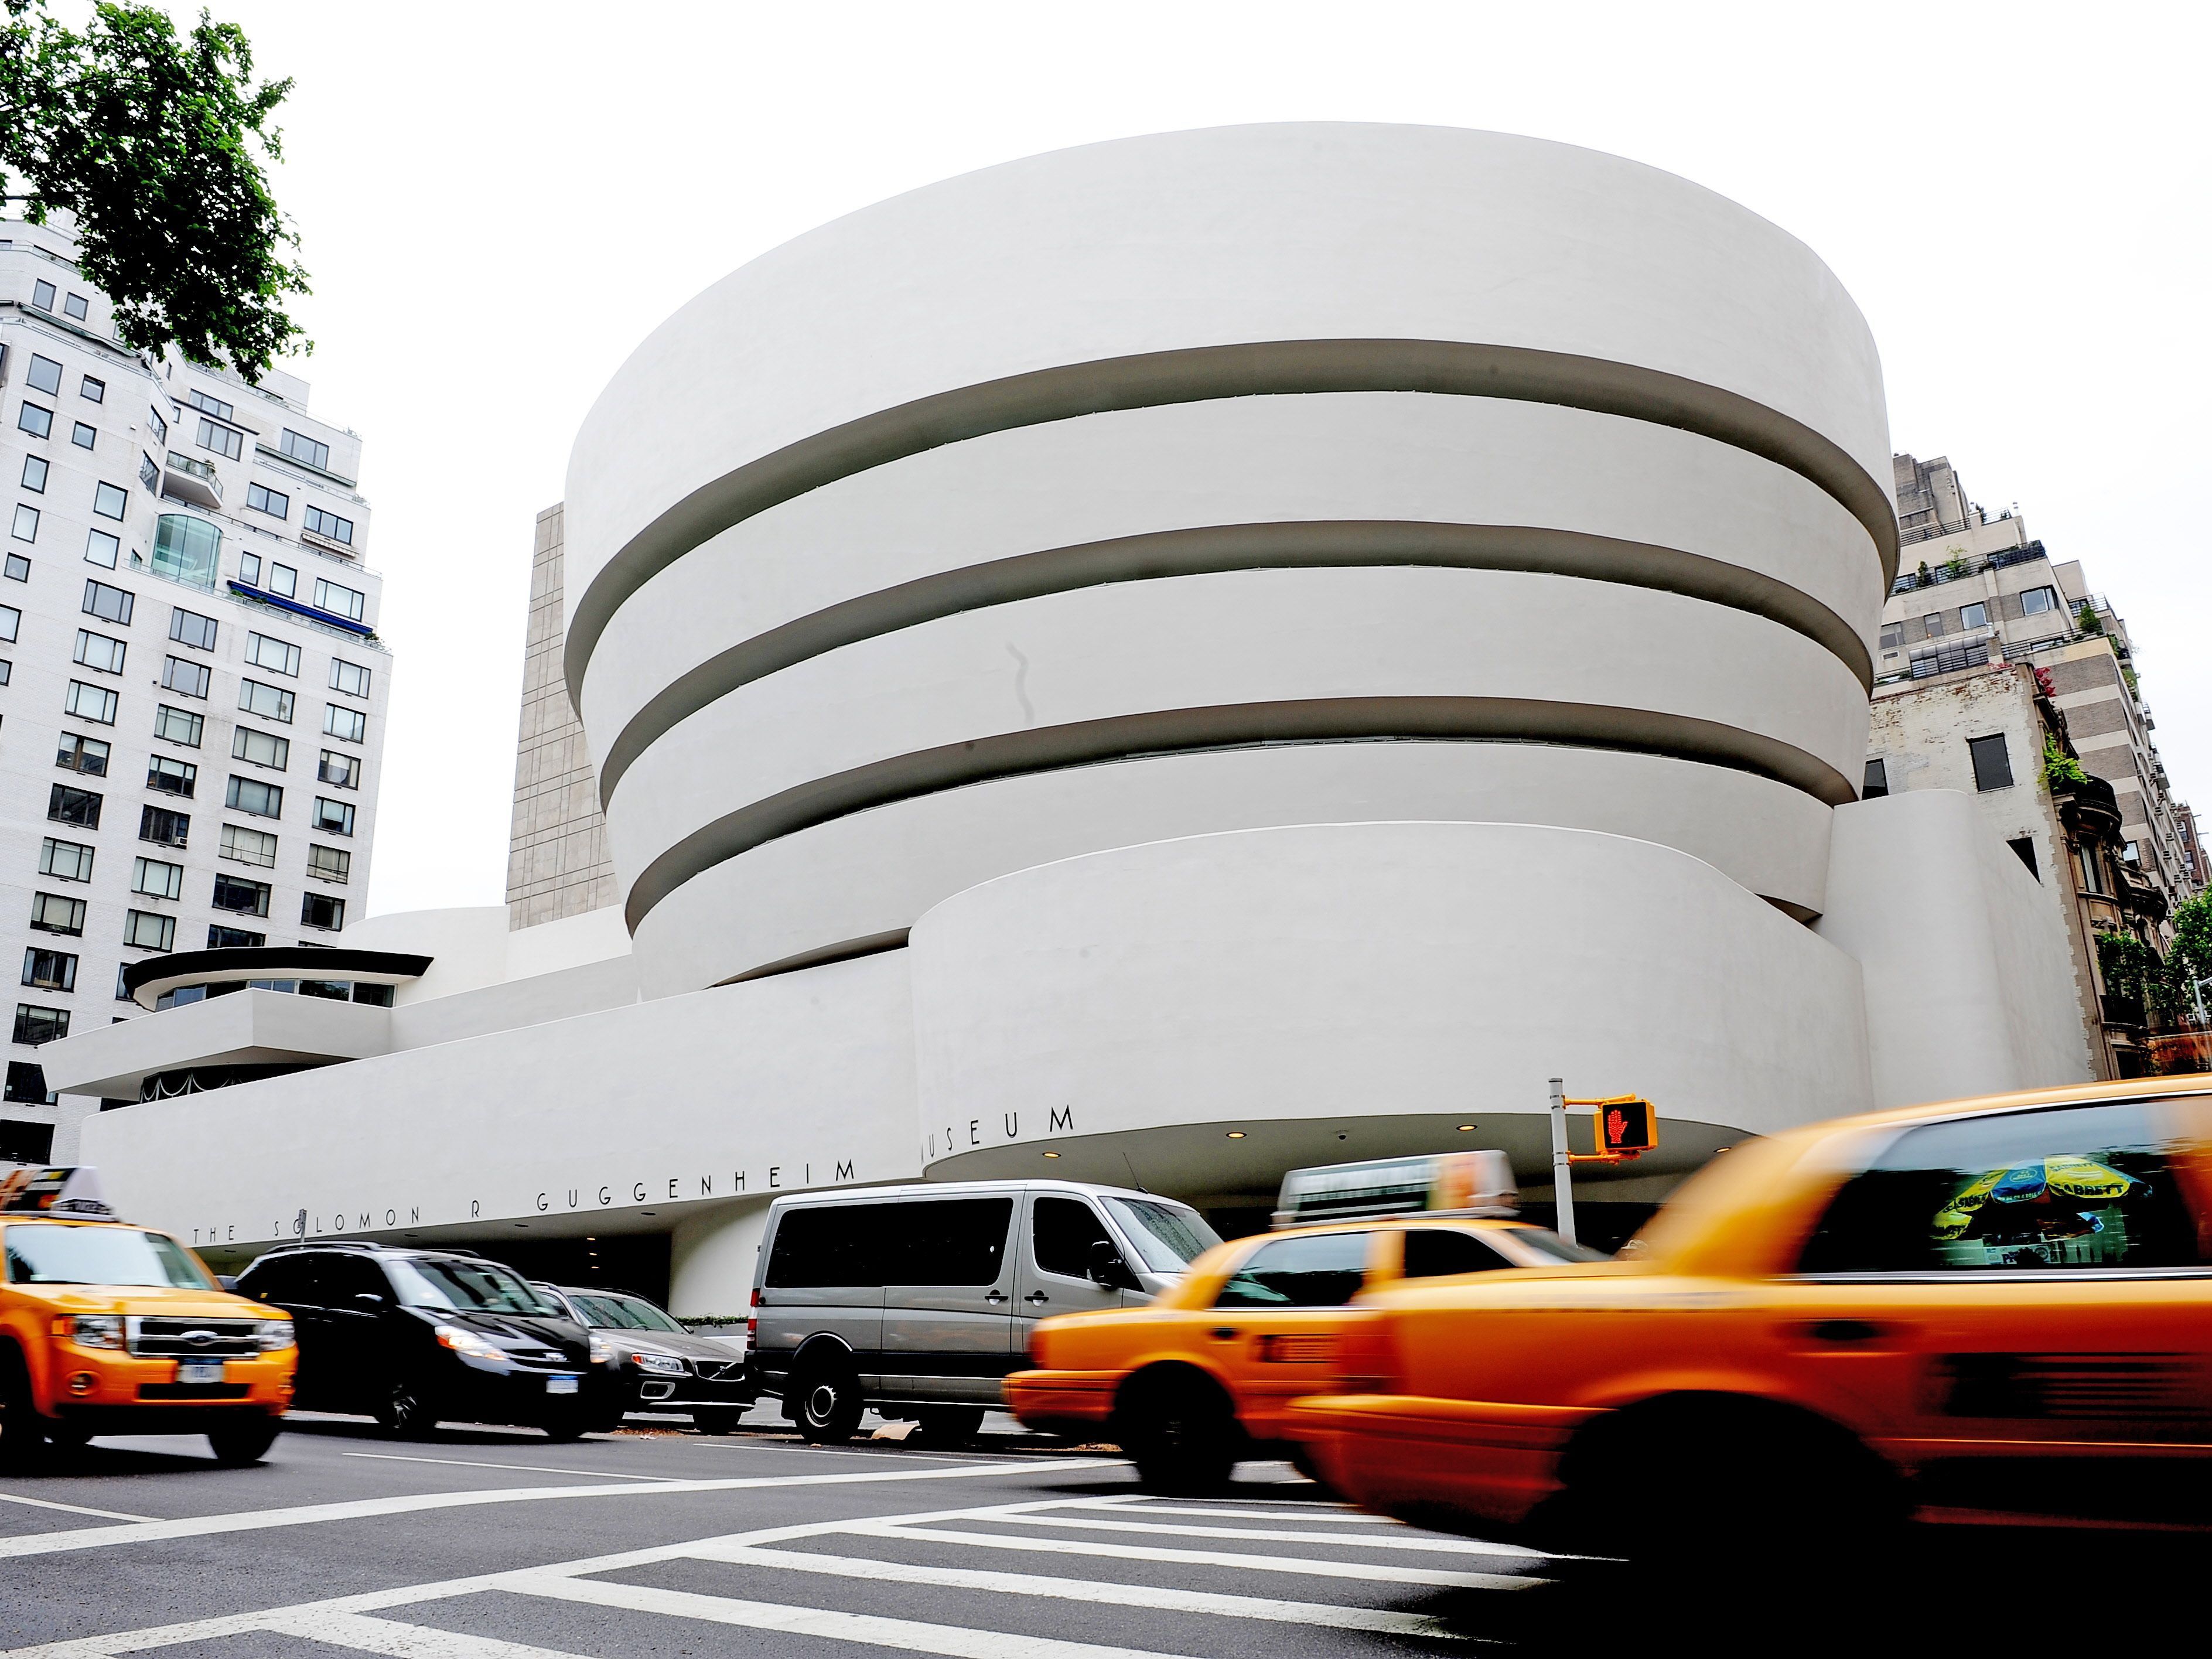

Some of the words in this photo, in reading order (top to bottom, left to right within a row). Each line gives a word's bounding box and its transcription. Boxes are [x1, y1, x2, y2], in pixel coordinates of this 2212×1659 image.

[193, 1225, 235, 1244] THE
[274, 1207, 419, 1237] SOLOMON
[471, 1200, 480, 1218] R
[537, 1159, 855, 1211] GUGGENHEIM
